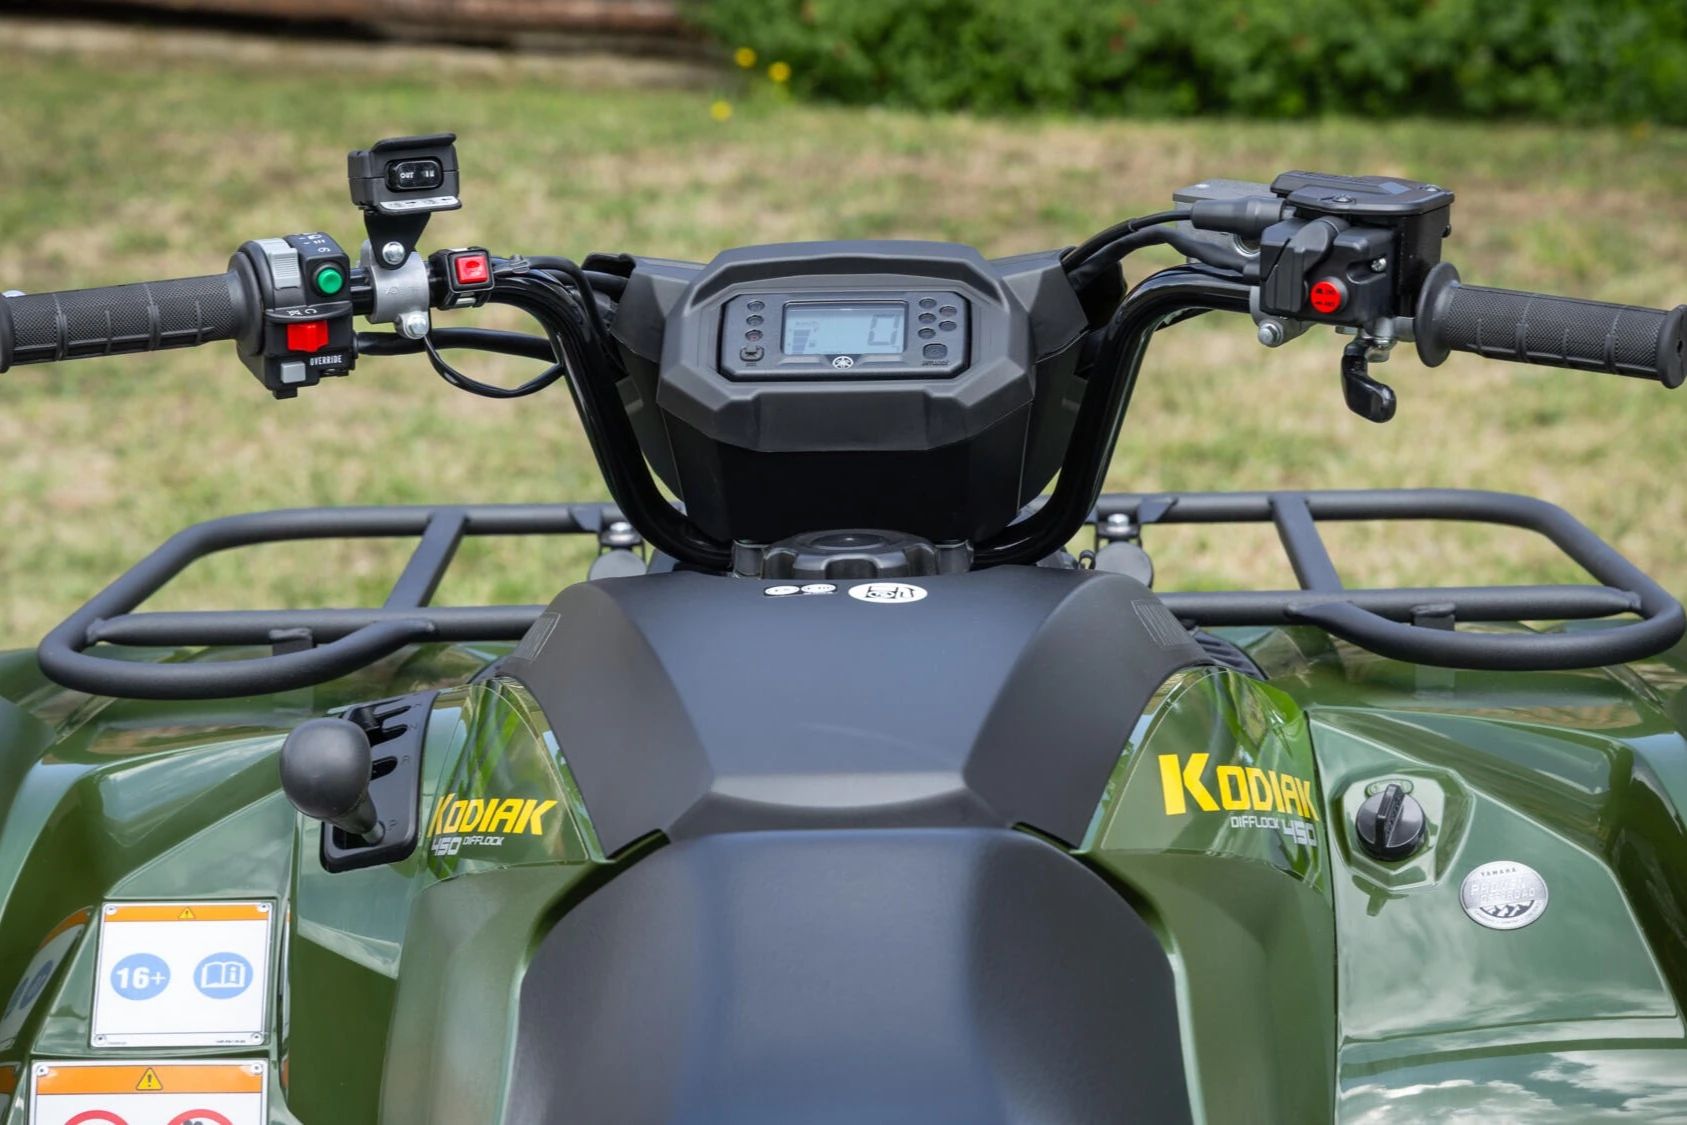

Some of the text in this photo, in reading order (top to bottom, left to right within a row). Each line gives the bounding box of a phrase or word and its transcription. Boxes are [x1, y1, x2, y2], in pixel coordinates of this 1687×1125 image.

[400, 171, 414, 179] OUT
[309, 354, 342, 366] OVERRIDE
[1158, 753, 1320, 821] KODIAK
[427, 793, 558, 838] KODIAK
[1282, 820, 1317, 847] 450
[431, 836, 505, 856] 450 DIFFLOCK
[1480, 867, 1517, 877] YAMAHA
[116, 966, 166, 989] 16+
